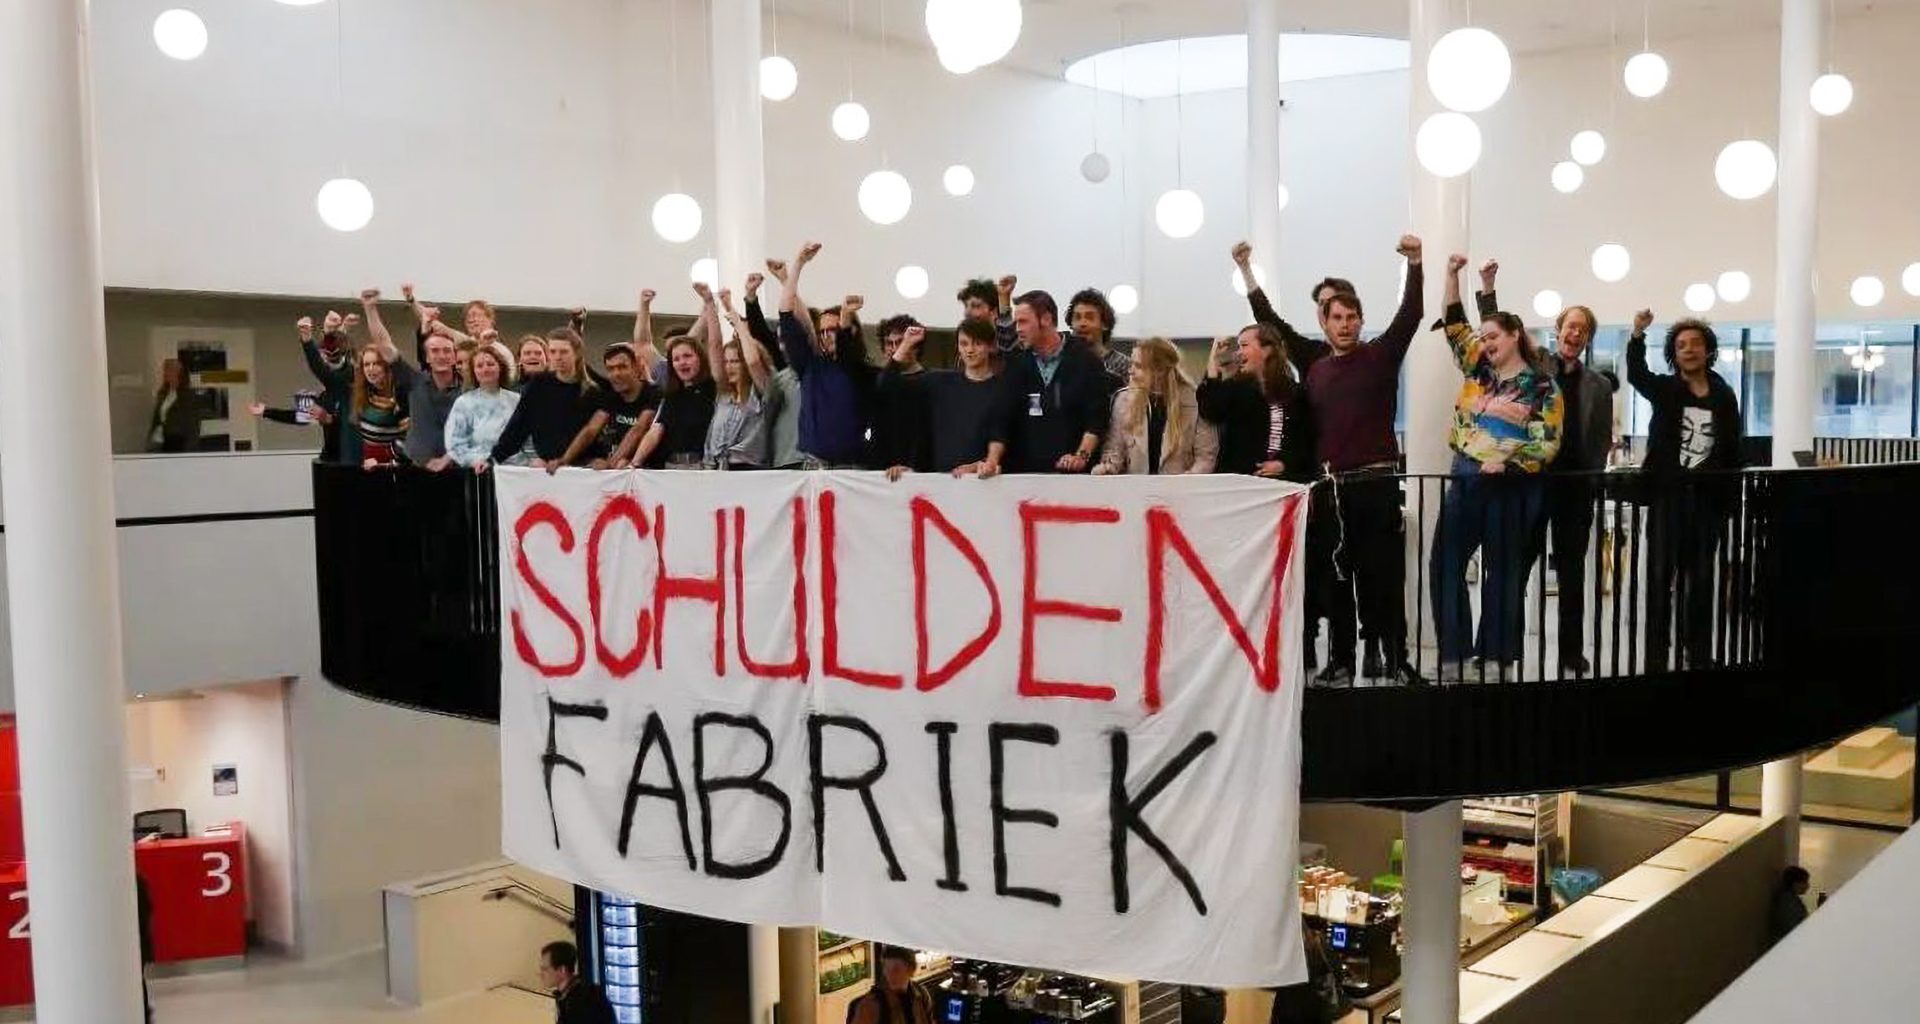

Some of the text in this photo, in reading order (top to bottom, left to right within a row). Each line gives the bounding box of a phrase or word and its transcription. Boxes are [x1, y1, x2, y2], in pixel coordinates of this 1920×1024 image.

[511, 489, 1303, 712] SCHULDEN
[202, 851, 232, 897] 3
[541, 696, 1217, 917] FABRIEK
